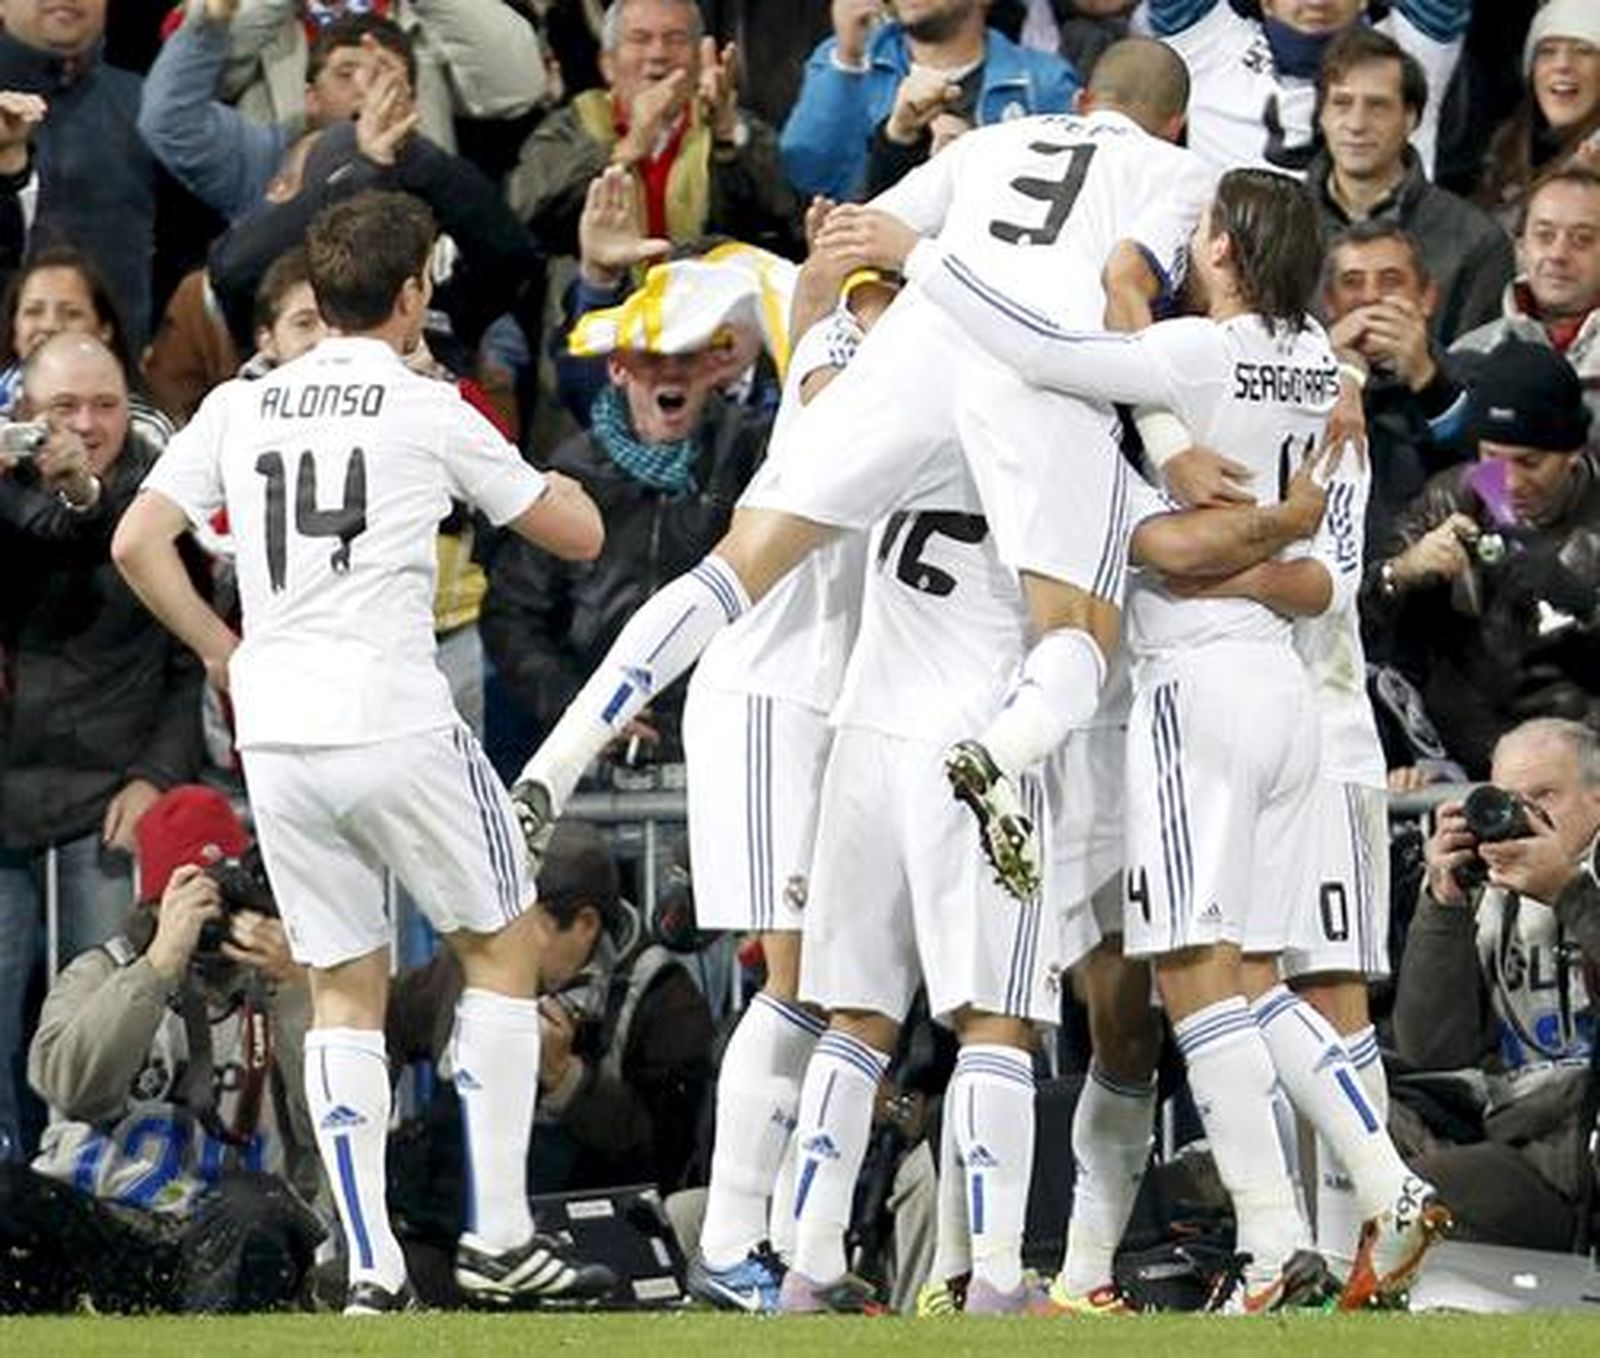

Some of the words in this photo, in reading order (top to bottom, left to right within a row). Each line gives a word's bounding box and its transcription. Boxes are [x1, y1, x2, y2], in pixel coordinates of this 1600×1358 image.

[988, 140, 1098, 246] 3
[260, 383, 386, 419] ALONSO
[254, 447, 368, 594] 14
[1128, 866, 1151, 923] 4
